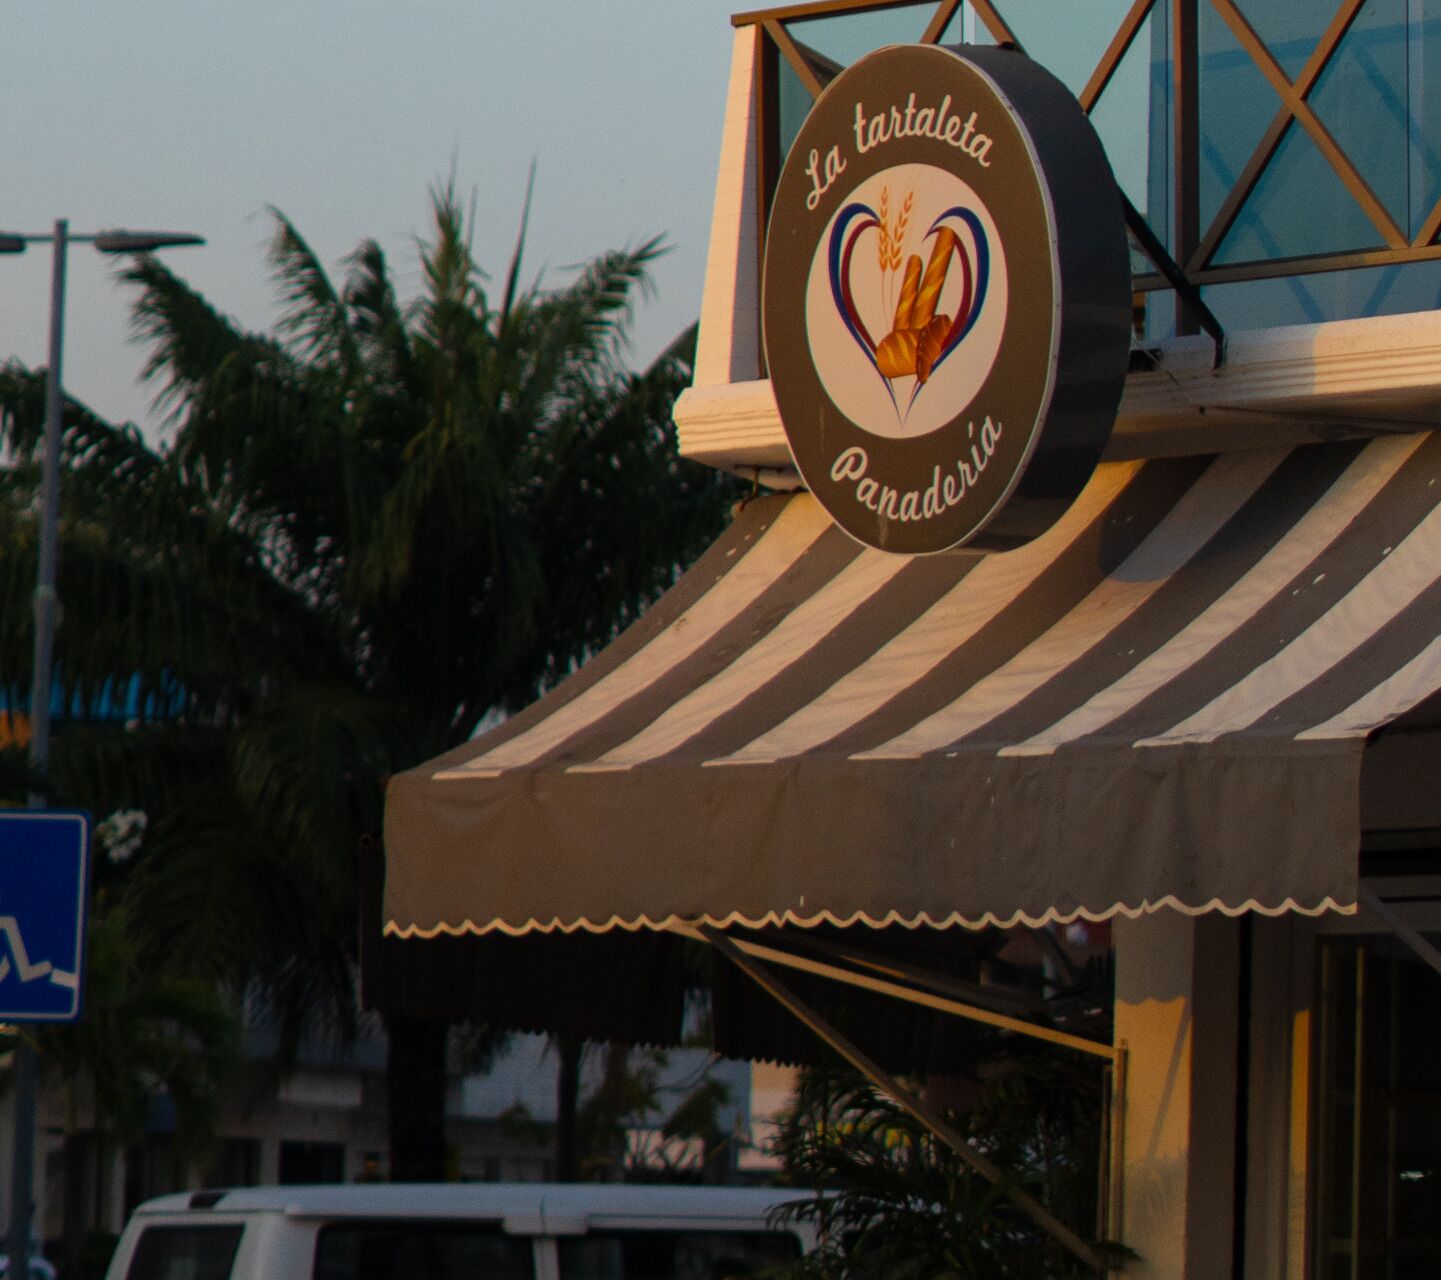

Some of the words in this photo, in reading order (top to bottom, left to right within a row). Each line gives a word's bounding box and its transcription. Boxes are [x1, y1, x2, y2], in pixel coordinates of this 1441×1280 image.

[806, 145, 847, 210] La
[853, 93, 994, 168] tartaleta
[830, 414, 1002, 522] Panadería
